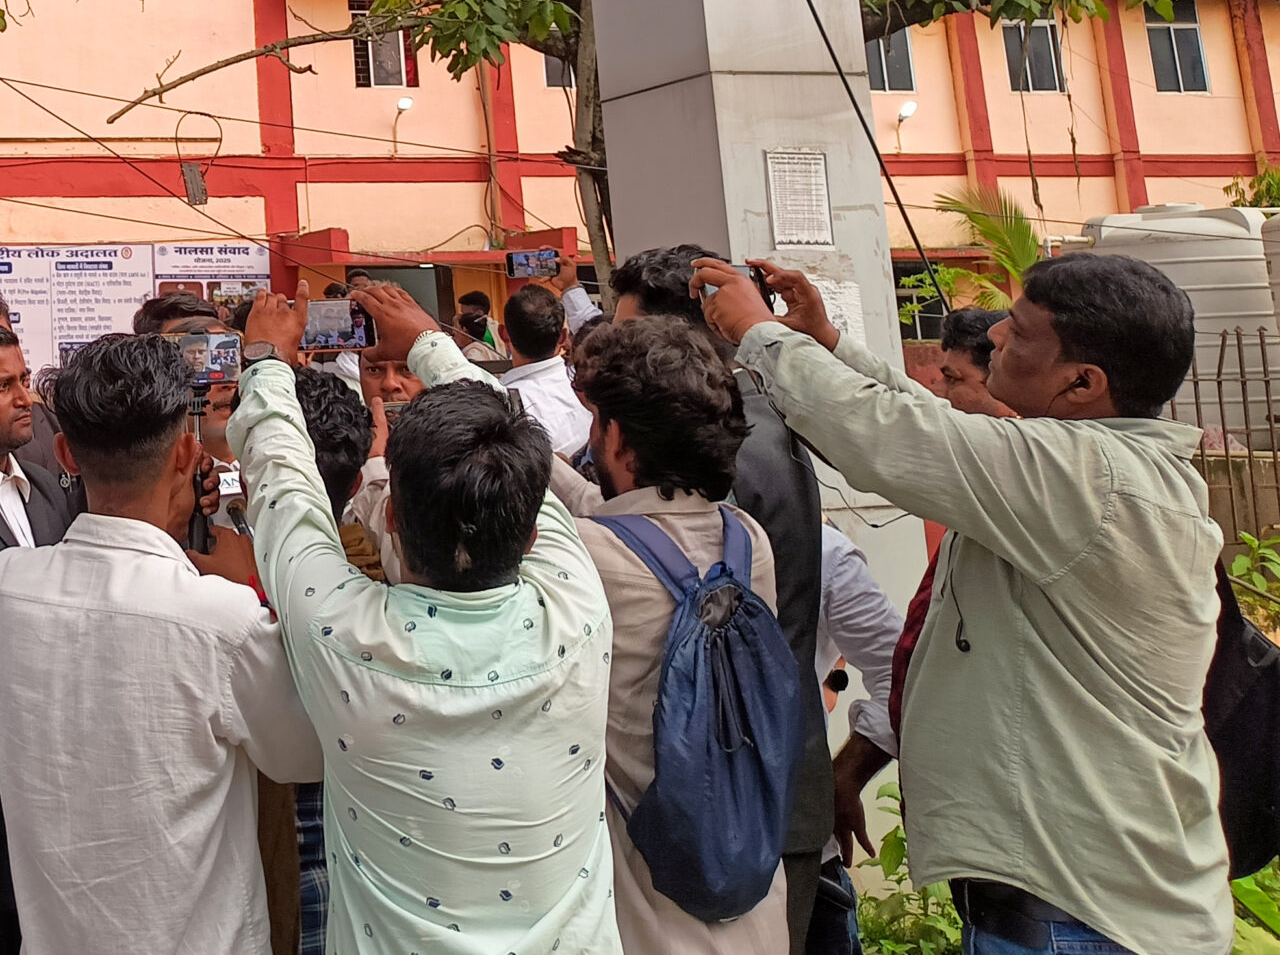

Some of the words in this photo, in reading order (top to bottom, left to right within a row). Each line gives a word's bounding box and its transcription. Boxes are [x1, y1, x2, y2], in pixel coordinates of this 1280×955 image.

[27, 247, 61, 259] लोक
[65, 249, 118, 259] अदालत
[173, 246, 214, 256] नालसा
[217, 244, 250, 256] संवाद
